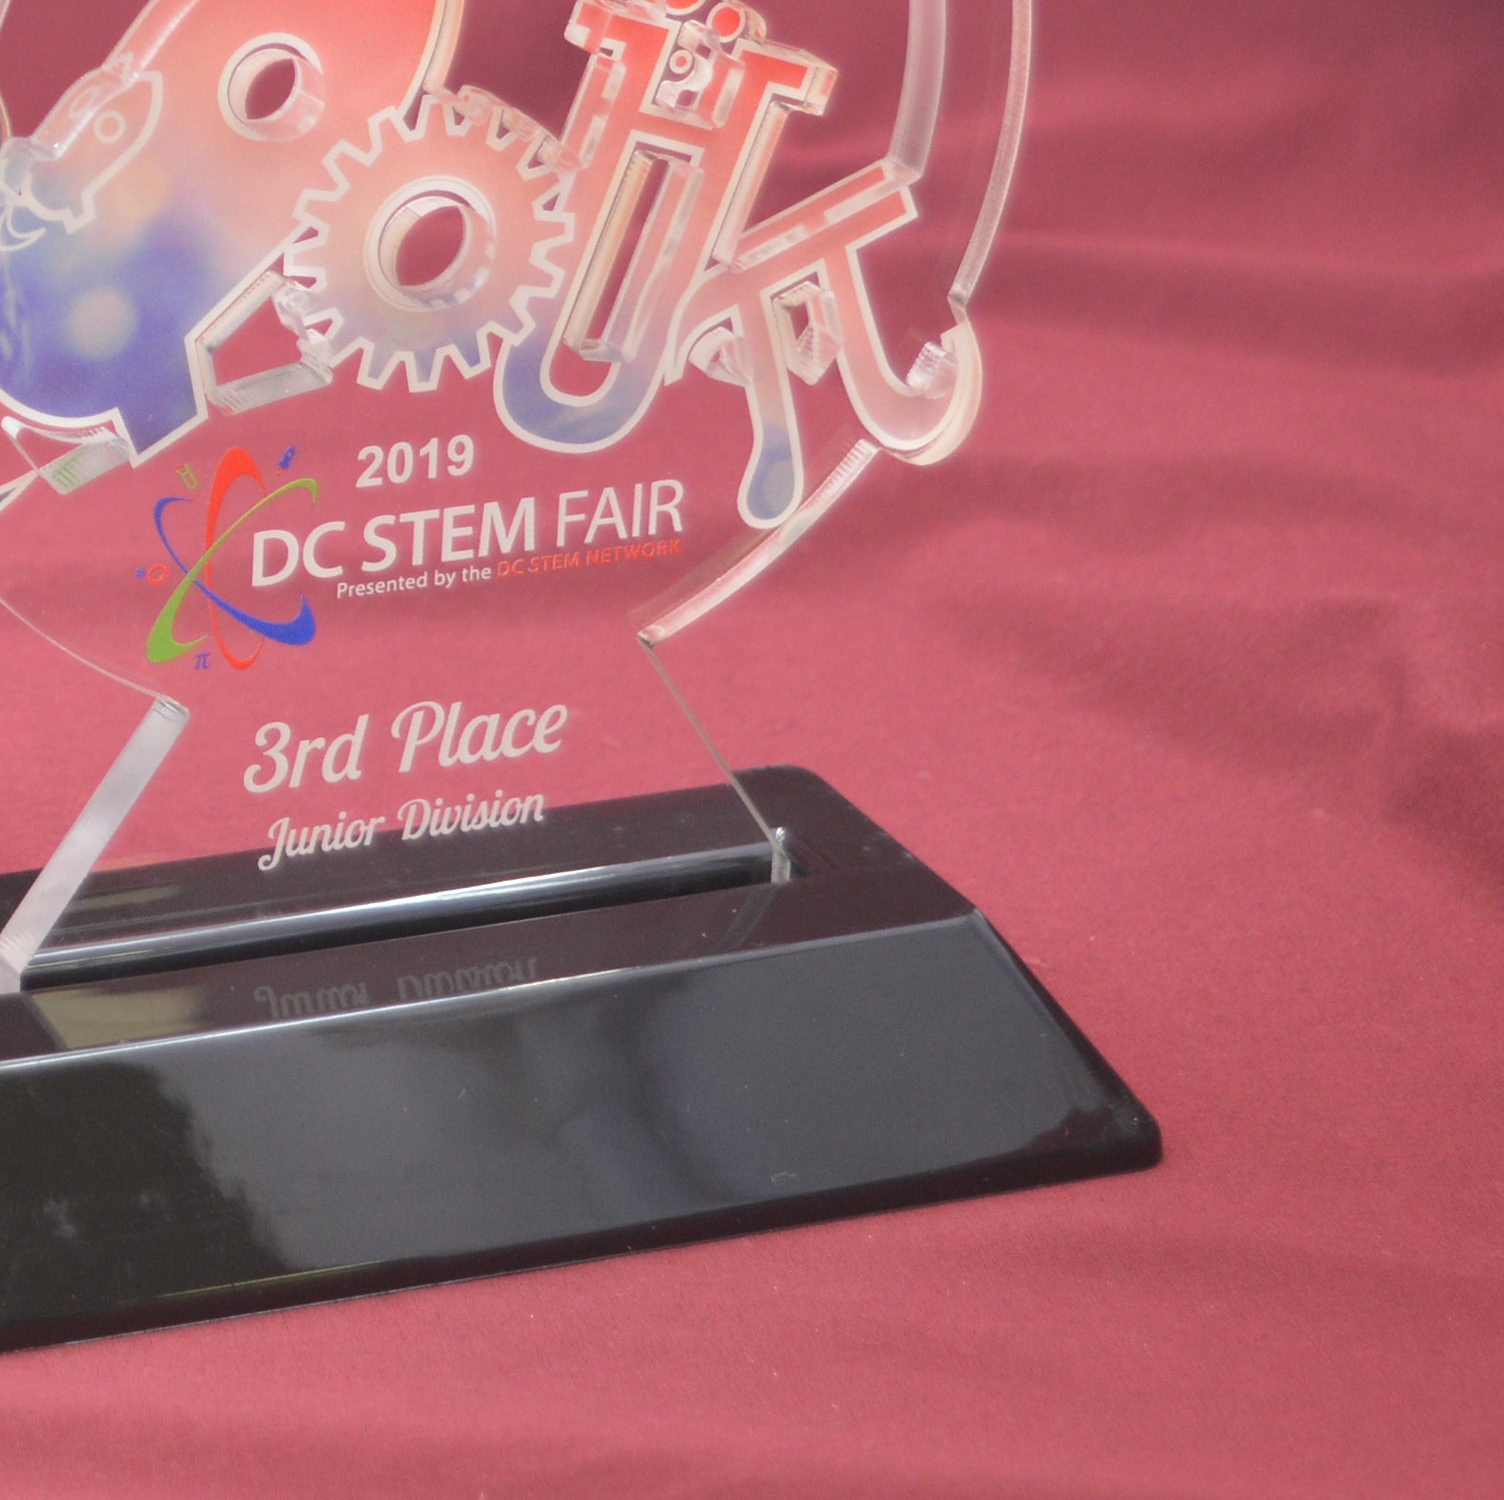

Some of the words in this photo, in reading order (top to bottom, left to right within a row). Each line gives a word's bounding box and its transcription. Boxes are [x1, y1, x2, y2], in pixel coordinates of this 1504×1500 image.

[356, 435, 474, 487] 2019
[252, 521, 347, 588] DC
[362, 497, 535, 574] STEM
[557, 479, 684, 546] FAIR
[336, 566, 427, 597] Presented
[435, 570, 456, 588] by
[462, 566, 491, 582] the
[499, 561, 525, 579] DC
[527, 552, 583, 575] STEM
[588, 539, 683, 566] NETWORK
[244, 714, 369, 793] 3rd
[392, 701, 568, 772] Place
[258, 811, 386, 871] Junior
[397, 789, 545, 840] Division
